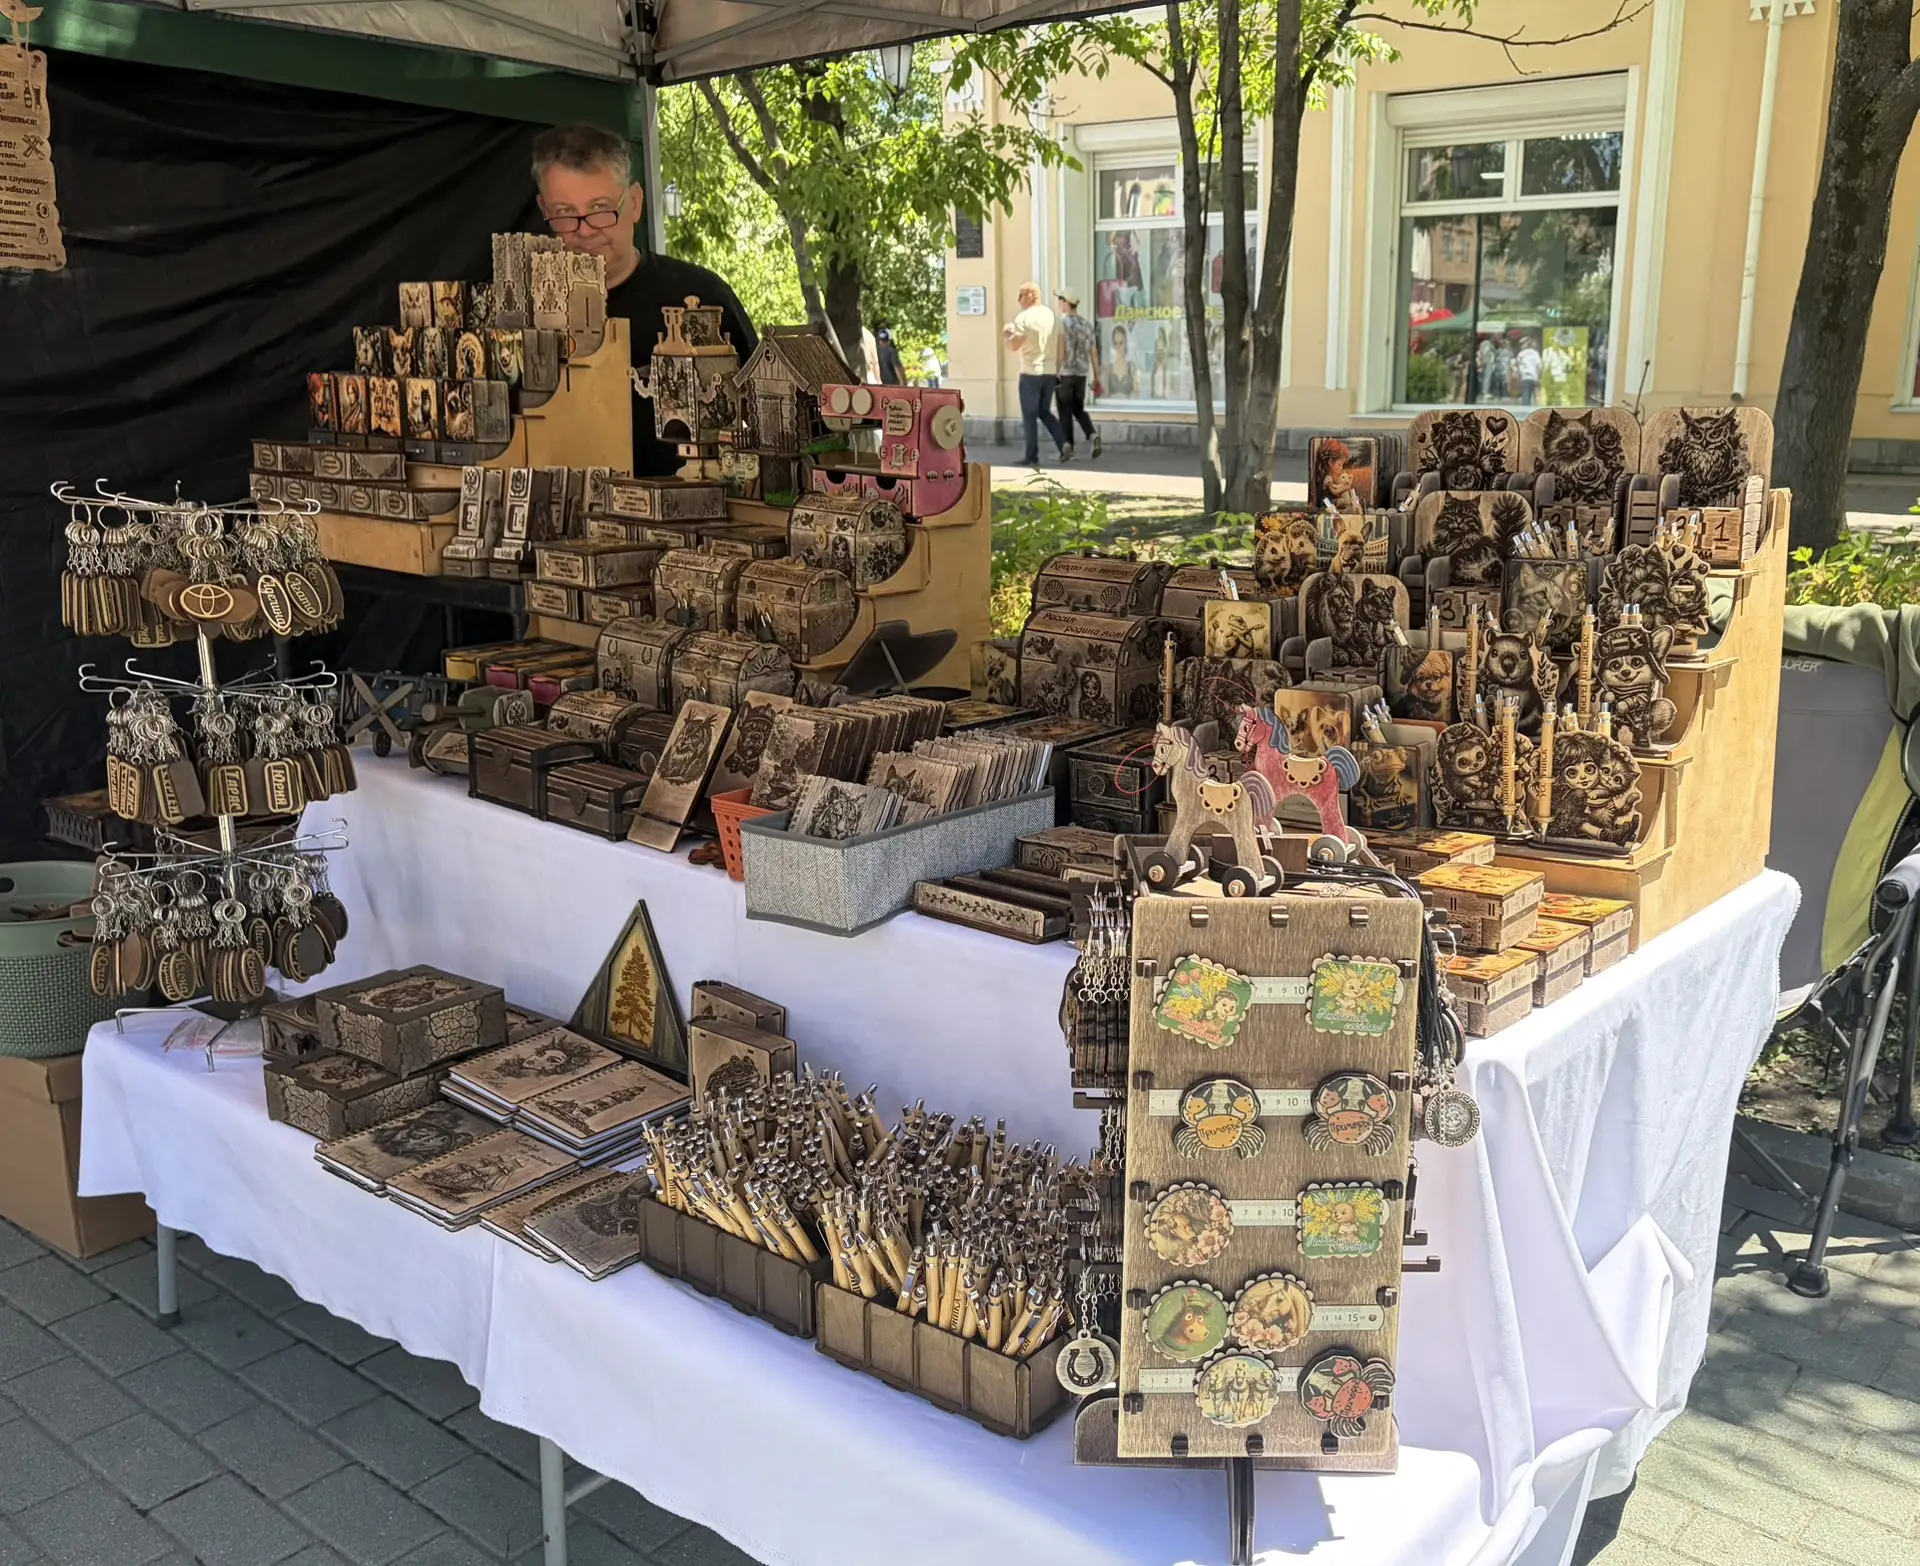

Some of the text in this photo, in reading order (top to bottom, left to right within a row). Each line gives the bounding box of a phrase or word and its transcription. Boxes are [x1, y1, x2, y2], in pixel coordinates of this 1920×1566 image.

[1713, 516, 1730, 542] 1
[286, 575, 317, 615] Агата
[261, 575, 287, 627] Аделина
[1440, 598, 1456, 621] 3
[1043, 612, 1077, 623] Россия
[1064, 625, 1100, 636] родина
[1294, 985, 1305, 995] 10
[1287, 1097, 1299, 1106] 10
[1283, 1208, 1294, 1217] 10
[1347, 1313, 1359, 1322] 15
